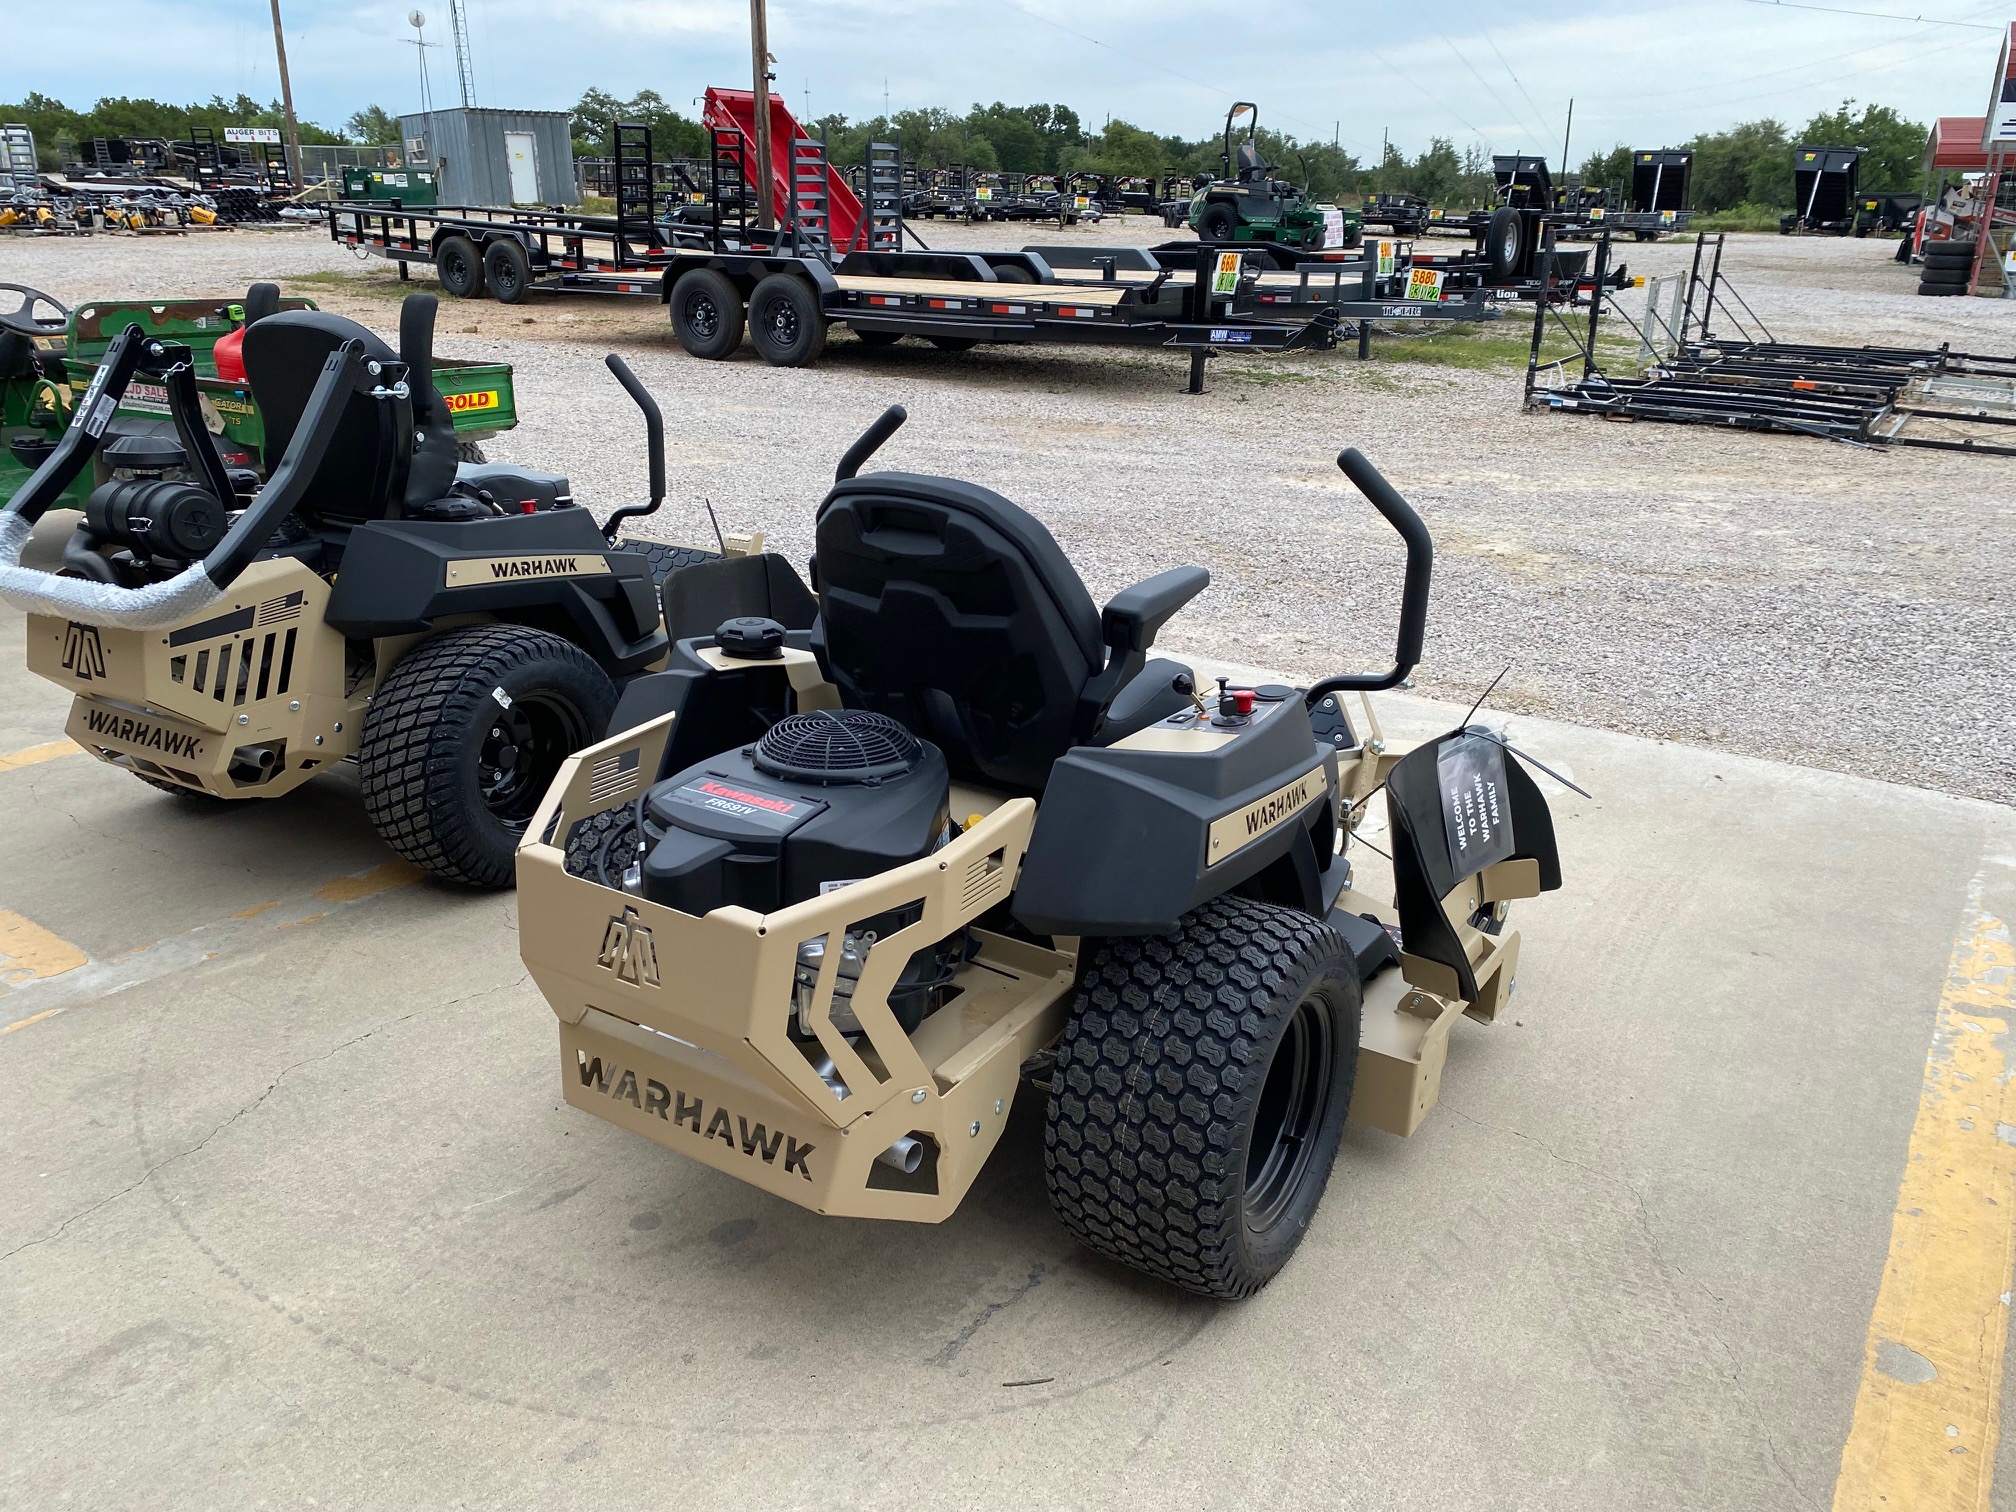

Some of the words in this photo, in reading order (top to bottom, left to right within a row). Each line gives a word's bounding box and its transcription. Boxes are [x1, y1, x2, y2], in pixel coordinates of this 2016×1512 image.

[1412, 270, 1437, 285] 5880
[1496, 289, 1519, 298] lion
[1210, 330, 1228, 338] AMW
[214, 398, 242, 411] GATOR
[444, 393, 489, 410] SOLD
[490, 558, 578, 578] WARHAWK
[88, 709, 202, 760] WARHAWK
[698, 782, 796, 814] Kawasaki
[704, 797, 758, 815] FR691V
[1245, 780, 1308, 835] WARHAWK
[1464, 790, 1475, 816] THE
[1473, 772, 1490, 843] WARHAWK
[1486, 781, 1500, 825] FAMILY
[1451, 786, 1467, 850] WELCOME
[1468, 819, 1478, 836] TO
[576, 1048, 816, 1183] WARHAWK
